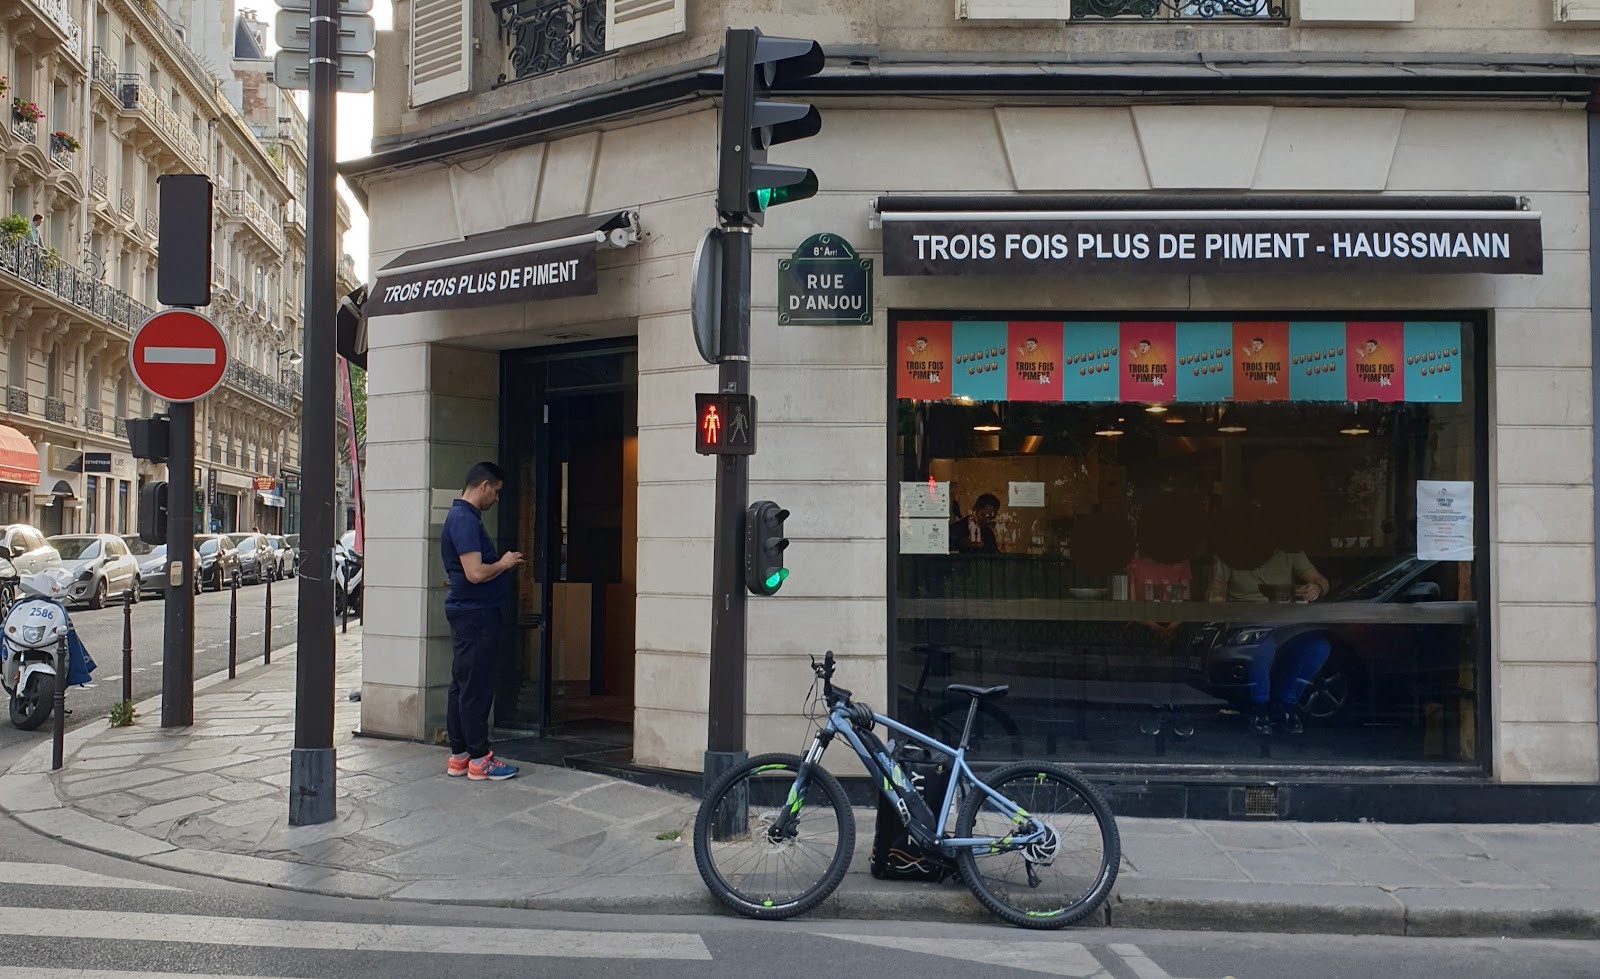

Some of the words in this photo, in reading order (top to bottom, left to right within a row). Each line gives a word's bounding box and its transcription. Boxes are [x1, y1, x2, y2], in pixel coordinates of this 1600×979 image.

[912, 233, 997, 260] TROIS
[1004, 233, 1069, 260] FOIS
[1077, 233, 1150, 260] PLUS
[1158, 233, 1196, 259] DE
[1205, 232, 1310, 259] PIMENT
[1333, 232, 1510, 259] HAUSSMANN
[383, 281, 422, 303] TROIS
[423, 276, 456, 298] FOIS
[457, 271, 496, 295] PLUS
[499, 268, 521, 290] DE
[523, 259, 579, 288] PIMENT
[807, 274, 844, 289] RUE
[789, 295, 862, 310] D'ANJOU
[955, 346, 1006, 365] OPENING
[1066, 347, 1118, 365] OPENING
[1179, 347, 1231, 365] OPENING
[1292, 346, 1344, 365] OPENING
[906, 361, 926, 370] TROIS
[928, 361, 944, 370] FOIS
[967, 361, 999, 375] SOON
[1015, 362, 1036, 371] TROIS
[1038, 362, 1054, 371] FOIS
[1079, 362, 1110, 376] SOON
[1128, 364, 1149, 373] TROIS
[1151, 364, 1168, 373] FOIS
[1192, 362, 1223, 376] SOON
[1241, 362, 1262, 371] TROIS
[1265, 362, 1281, 371] FOIS
[1305, 362, 1336, 376] SOON
[1355, 364, 1377, 372] TROIS
[1378, 364, 1395, 372] FOIS
[29, 607, 54, 620] 2586
